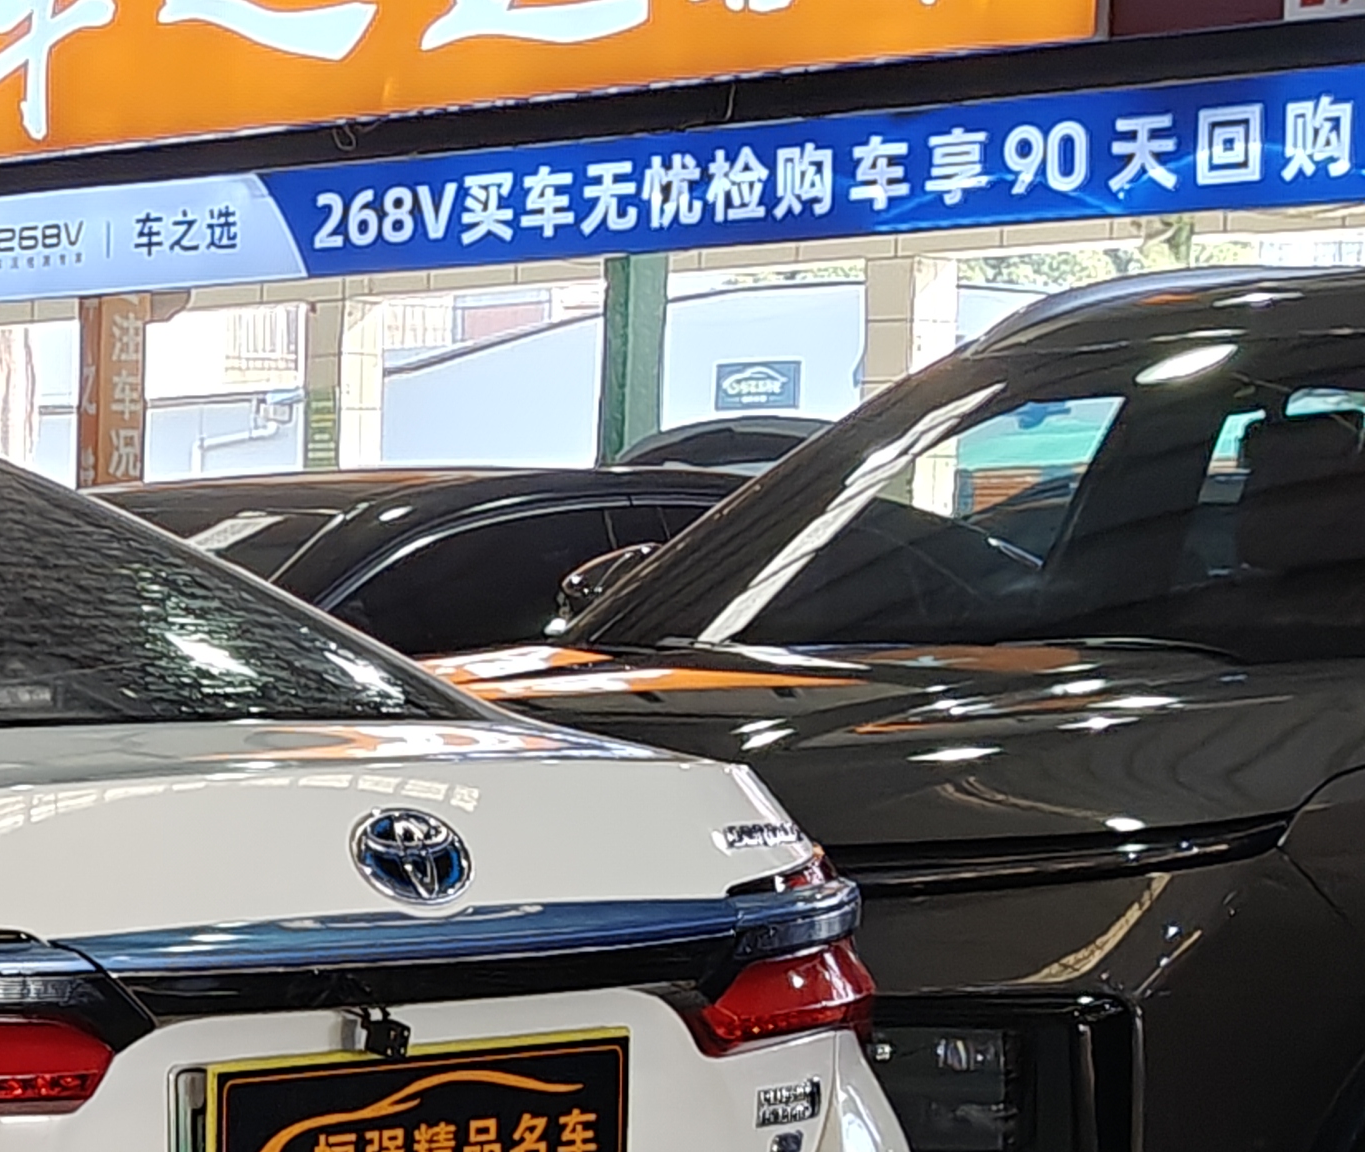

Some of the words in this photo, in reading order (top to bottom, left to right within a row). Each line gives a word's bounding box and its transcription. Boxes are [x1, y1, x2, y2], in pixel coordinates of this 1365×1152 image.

[133, 206, 239, 257] 车之选
[109, 295, 141, 478] 注车况
